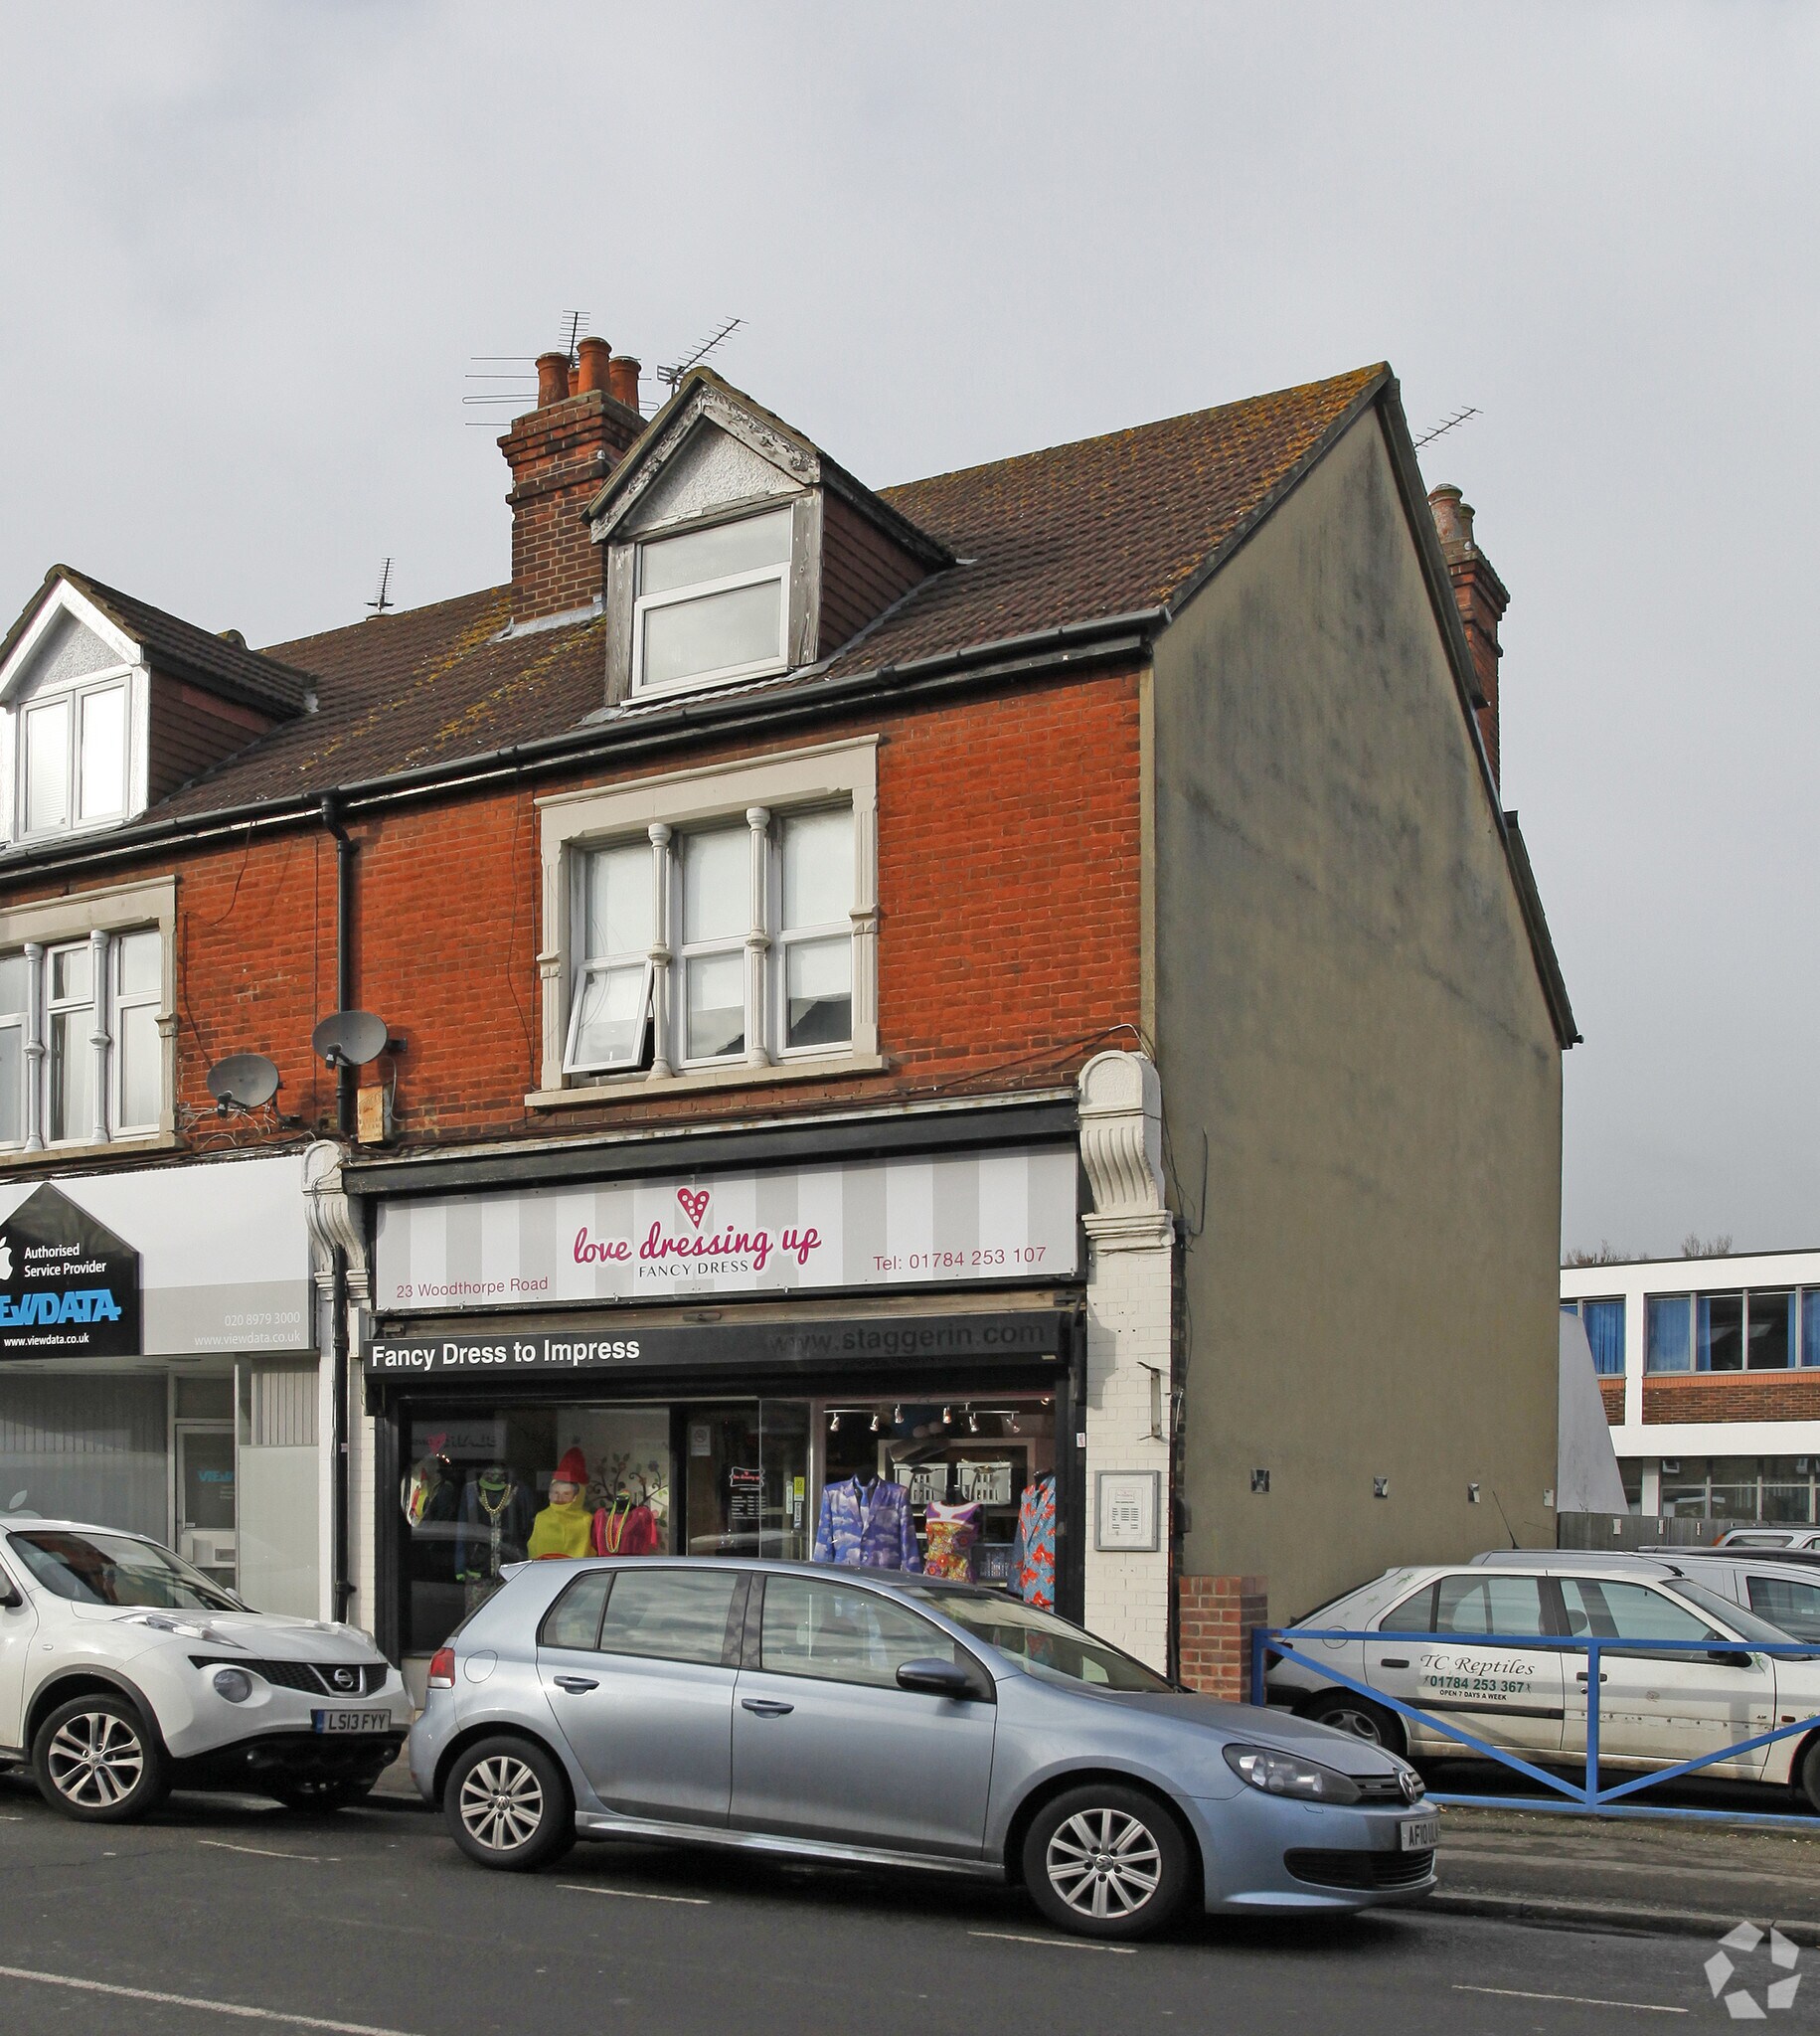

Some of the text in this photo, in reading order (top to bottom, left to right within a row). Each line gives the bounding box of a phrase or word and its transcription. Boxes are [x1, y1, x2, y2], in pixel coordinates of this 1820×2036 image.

[24, 1243, 81, 1260] Authorised
[574, 1221, 822, 1271] love dressing up
[873, 1247, 1047, 1271] Tel: 01784 253 107
[24, 1260, 107, 1277] Service Provider
[639, 1260, 748, 1277] FANCY DRESS
[397, 1276, 548, 1298] 23 Woodthorpe Road
[225, 1311, 301, 1326] 020 8979 3000
[4, 1332, 89, 1347] www.viewdata.co.uk
[195, 1330, 301, 1346] www.viewdata.co.uk
[372, 1339, 640, 1371] Fancy Dress to Impress
[1420, 1654, 1535, 1676] TC Reptiles
[1430, 1676, 1524, 1693] 01784 253 367
[328, 1713, 386, 1730] LS13 FYY
